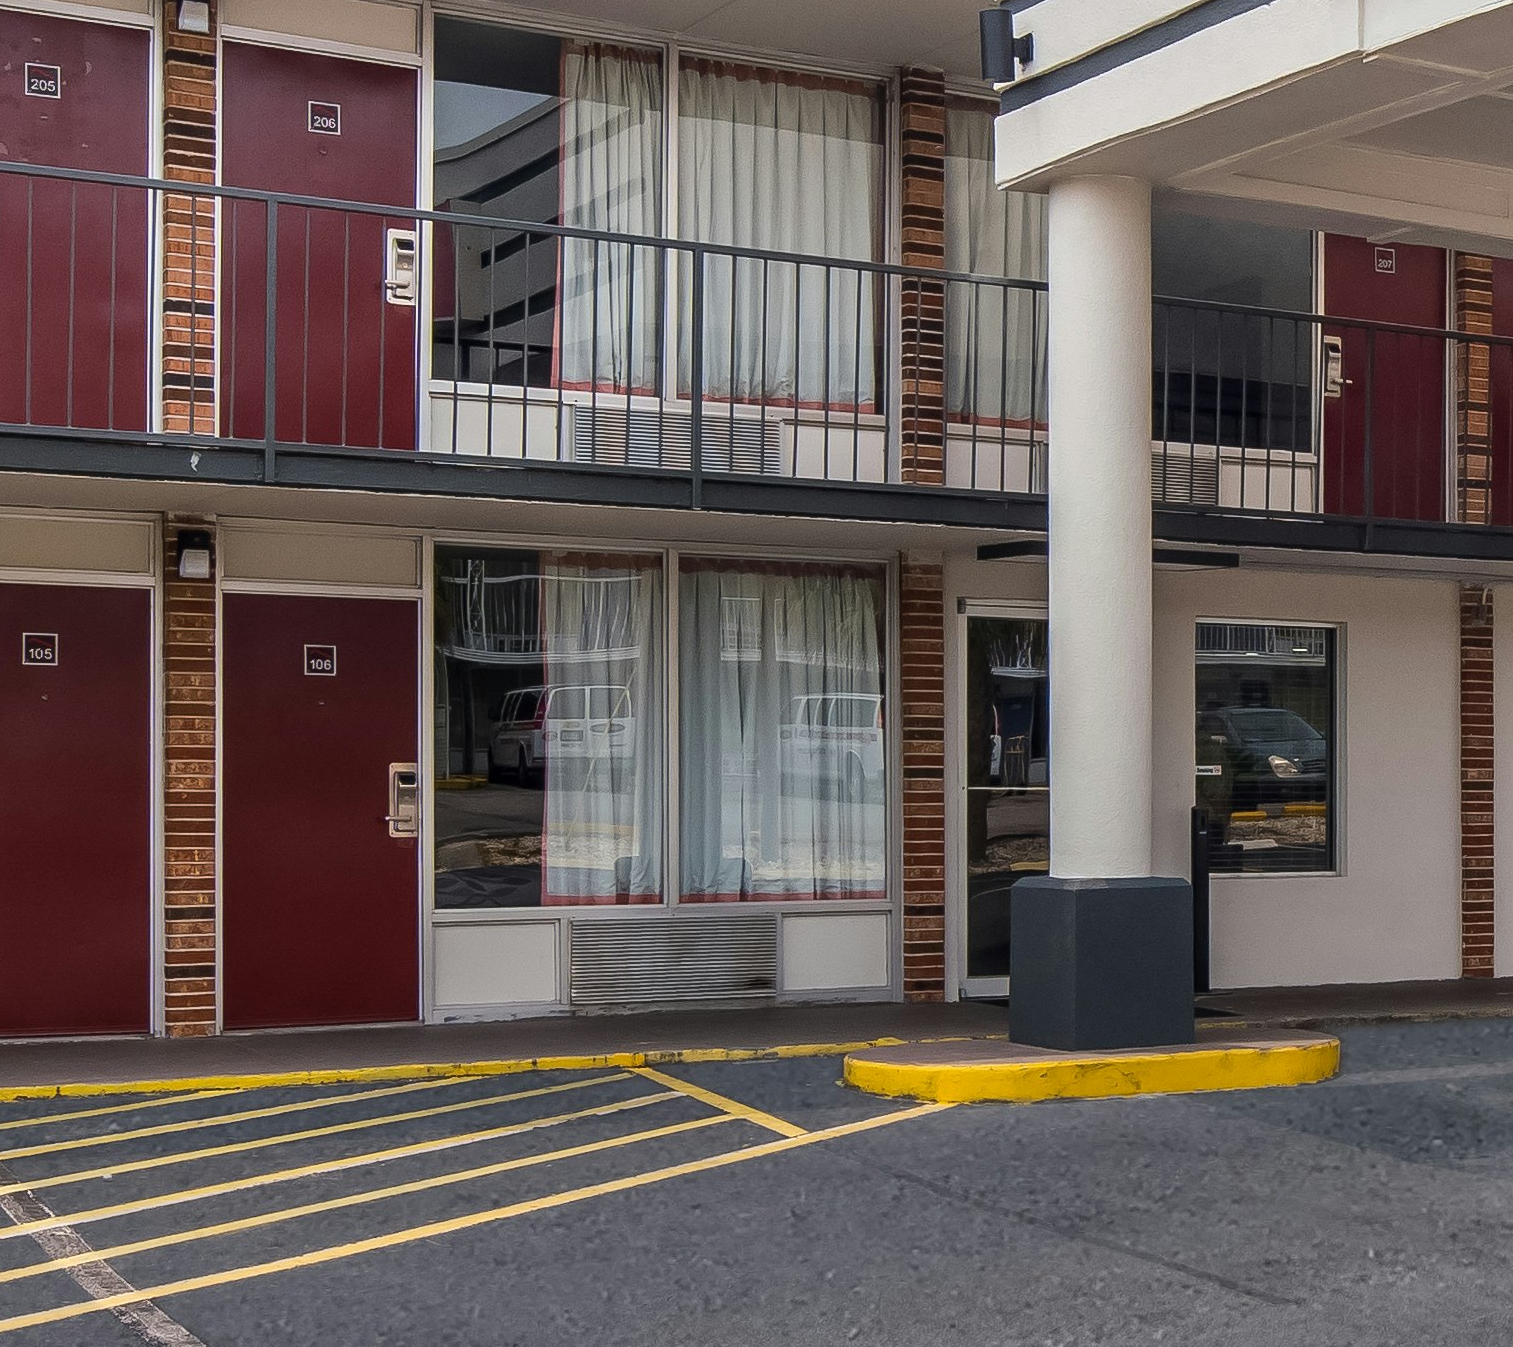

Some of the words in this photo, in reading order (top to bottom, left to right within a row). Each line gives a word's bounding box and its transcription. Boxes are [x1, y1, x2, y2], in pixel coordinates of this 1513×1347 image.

[30, 78, 56, 92] 205
[313, 115, 337, 129] 206
[1378, 258, 1393, 269] 207
[28, 647, 53, 660] 105
[310, 658, 332, 671] 106
